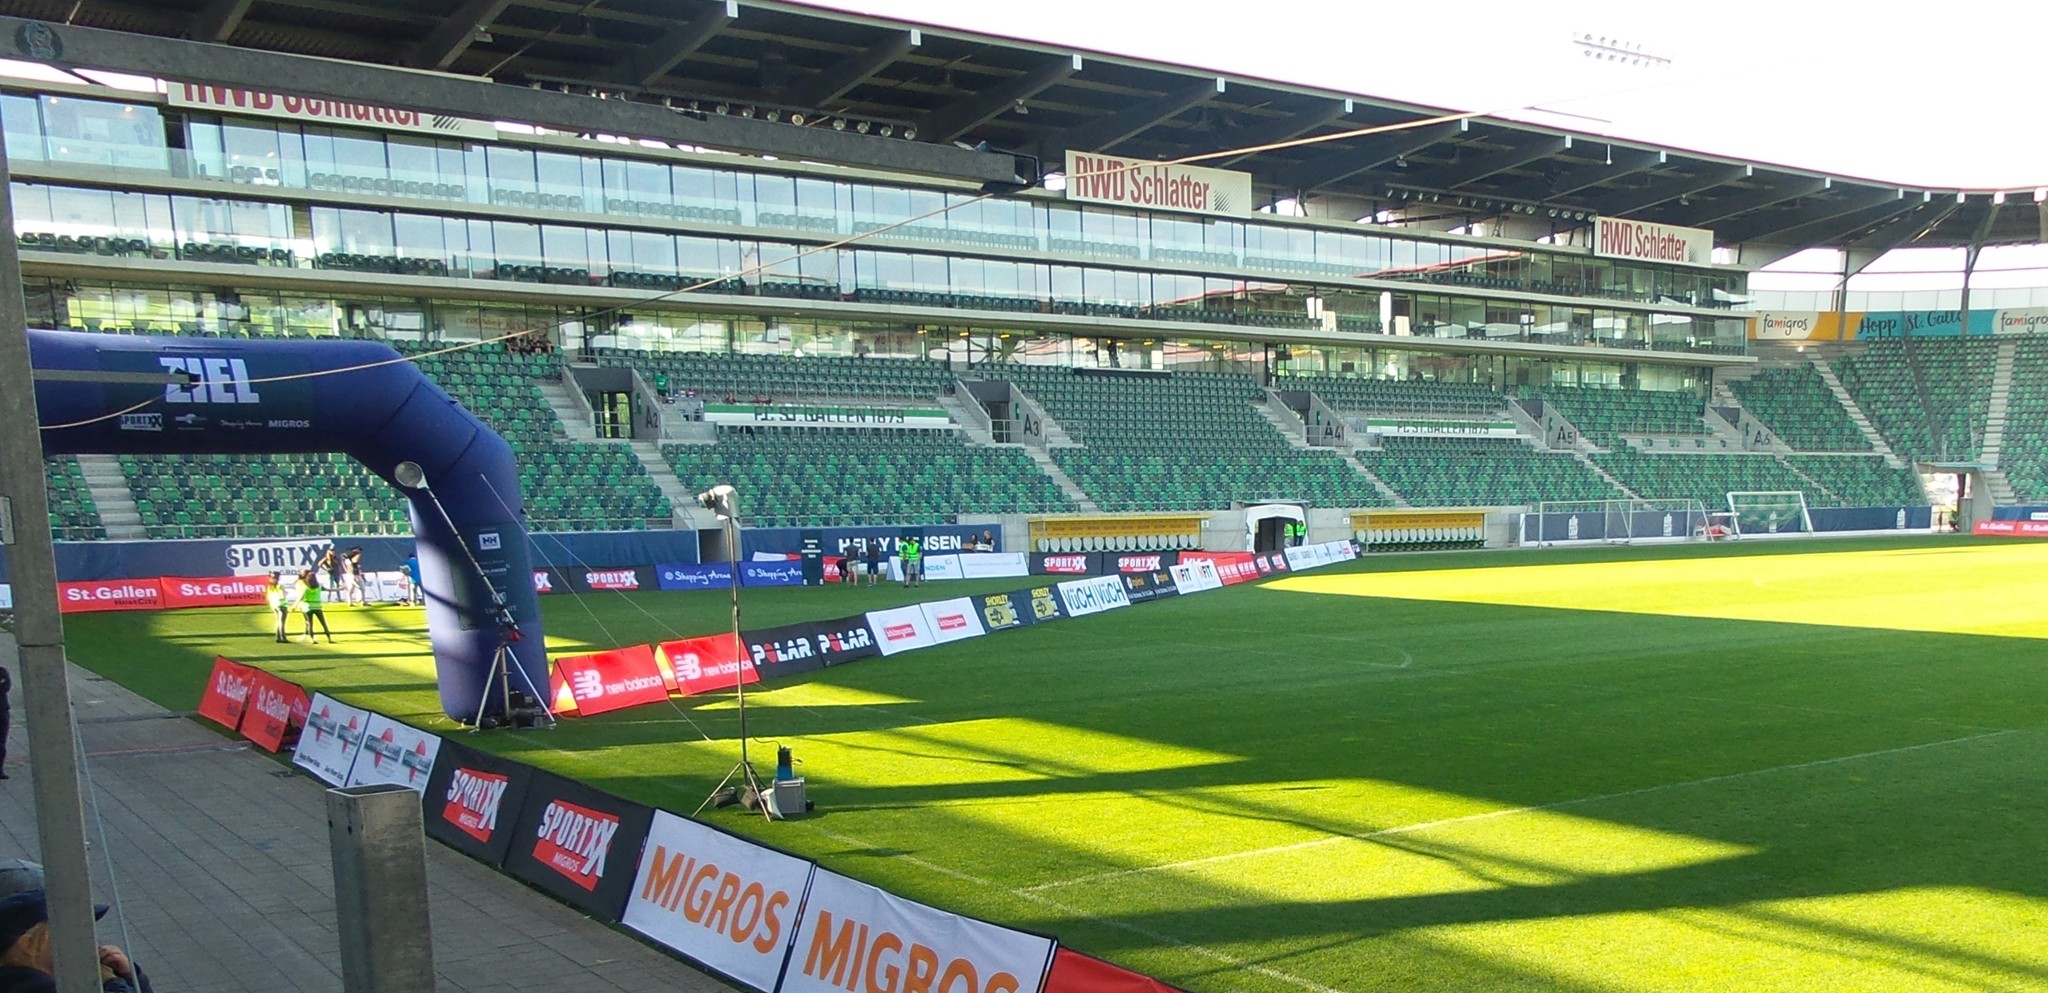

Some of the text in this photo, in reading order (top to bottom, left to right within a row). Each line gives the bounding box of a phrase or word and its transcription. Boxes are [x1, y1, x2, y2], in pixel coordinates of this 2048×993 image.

[1075, 156, 1210, 210] RWD Schlatter
[1600, 220, 1687, 262] RWD Schlatter
[1763, 313, 1808, 336] famigros
[1859, 317, 1897, 338] Hopp
[2001, 311, 2048, 334] famigro
[159, 357, 260, 403] ZIEL
[268, 420, 310, 428] MIGROS
[645, 405, 659, 429] A2
[871, 409, 904, 424] 1879
[1023, 413, 1039, 437] A3
[1323, 420, 1341, 441] A4
[1468, 422, 1489, 435] 1879
[1556, 425, 1573, 445] A5
[1753, 430, 1770, 446] A6
[1043, 555, 1087, 571] SPORTXX
[1118, 555, 1161, 571] SPORTXX
[586, 570, 639, 587] SPORTXX
[675, 571, 708, 585] Shopping
[67, 586, 157, 601] St.Gallen
[181, 582, 266, 597] St.Gallen
[752, 637, 813, 665] POLAR
[818, 628, 871, 654] POLAR
[703, 665, 720, 677] new
[605, 682, 625, 695] new
[625, 674, 662, 692] balance
[447, 769, 508, 831] SPORTXX
[457, 812, 479, 828] MIGROS
[538, 802, 620, 878] SPORTXX
[553, 851, 581, 873] MIGROS
[641, 844, 790, 956] MIGROS
